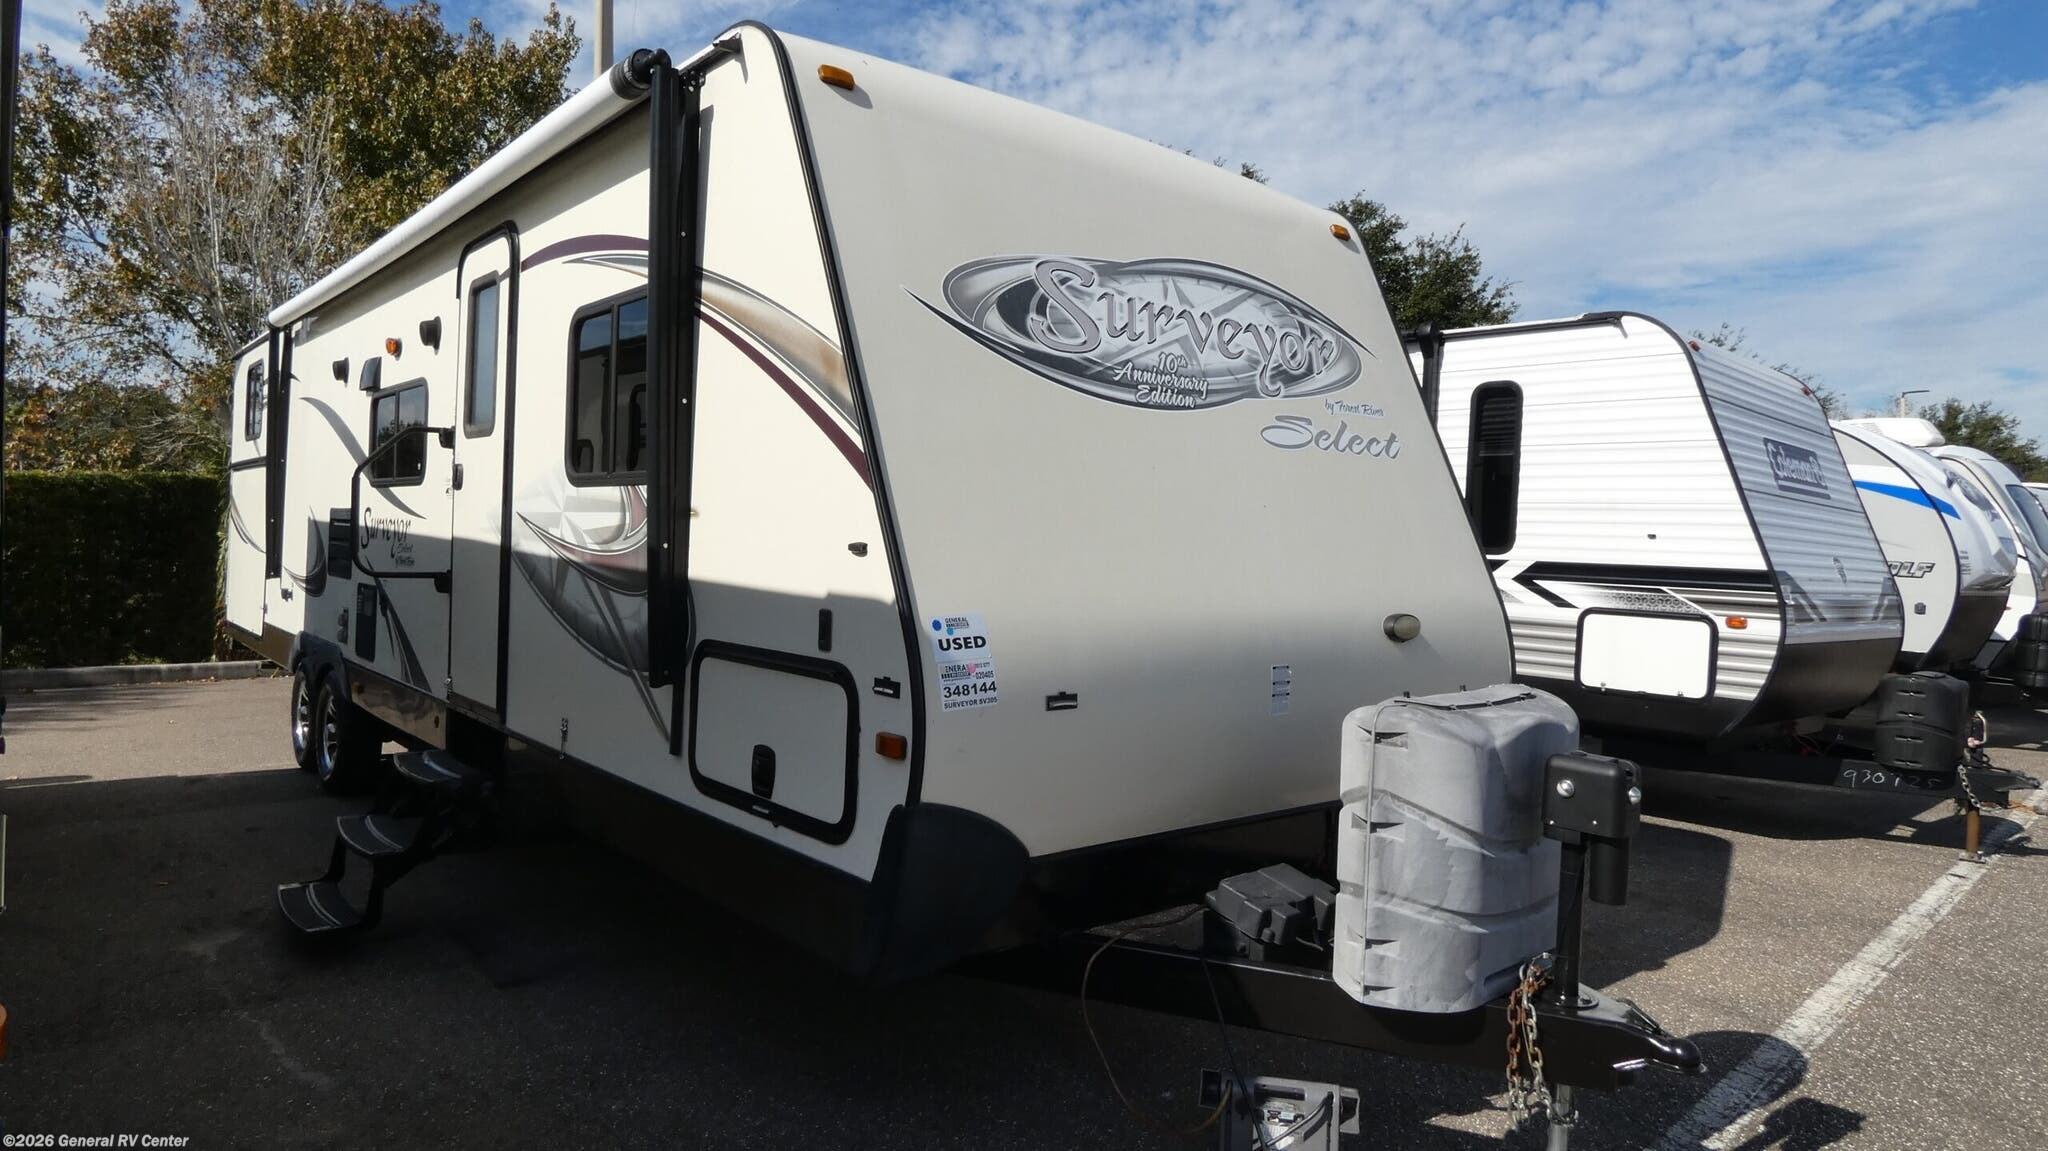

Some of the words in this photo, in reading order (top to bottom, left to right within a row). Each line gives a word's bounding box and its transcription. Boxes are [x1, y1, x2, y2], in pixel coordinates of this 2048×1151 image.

[1029, 258, 1335, 398] Surveyor
[1158, 352, 1188, 374] 10th
[1112, 361, 1209, 400] Anniversary
[1135, 384, 1196, 409] Edition
[1324, 398, 1334, 416] by
[1260, 414, 1401, 460] Select
[361, 506, 412, 559] Surveyor
[1888, 560, 1936, 579] OLF
[938, 635, 987, 652] USED
[943, 681, 997, 699] 348144
[944, 699, 978, 710] SURVEYOR
